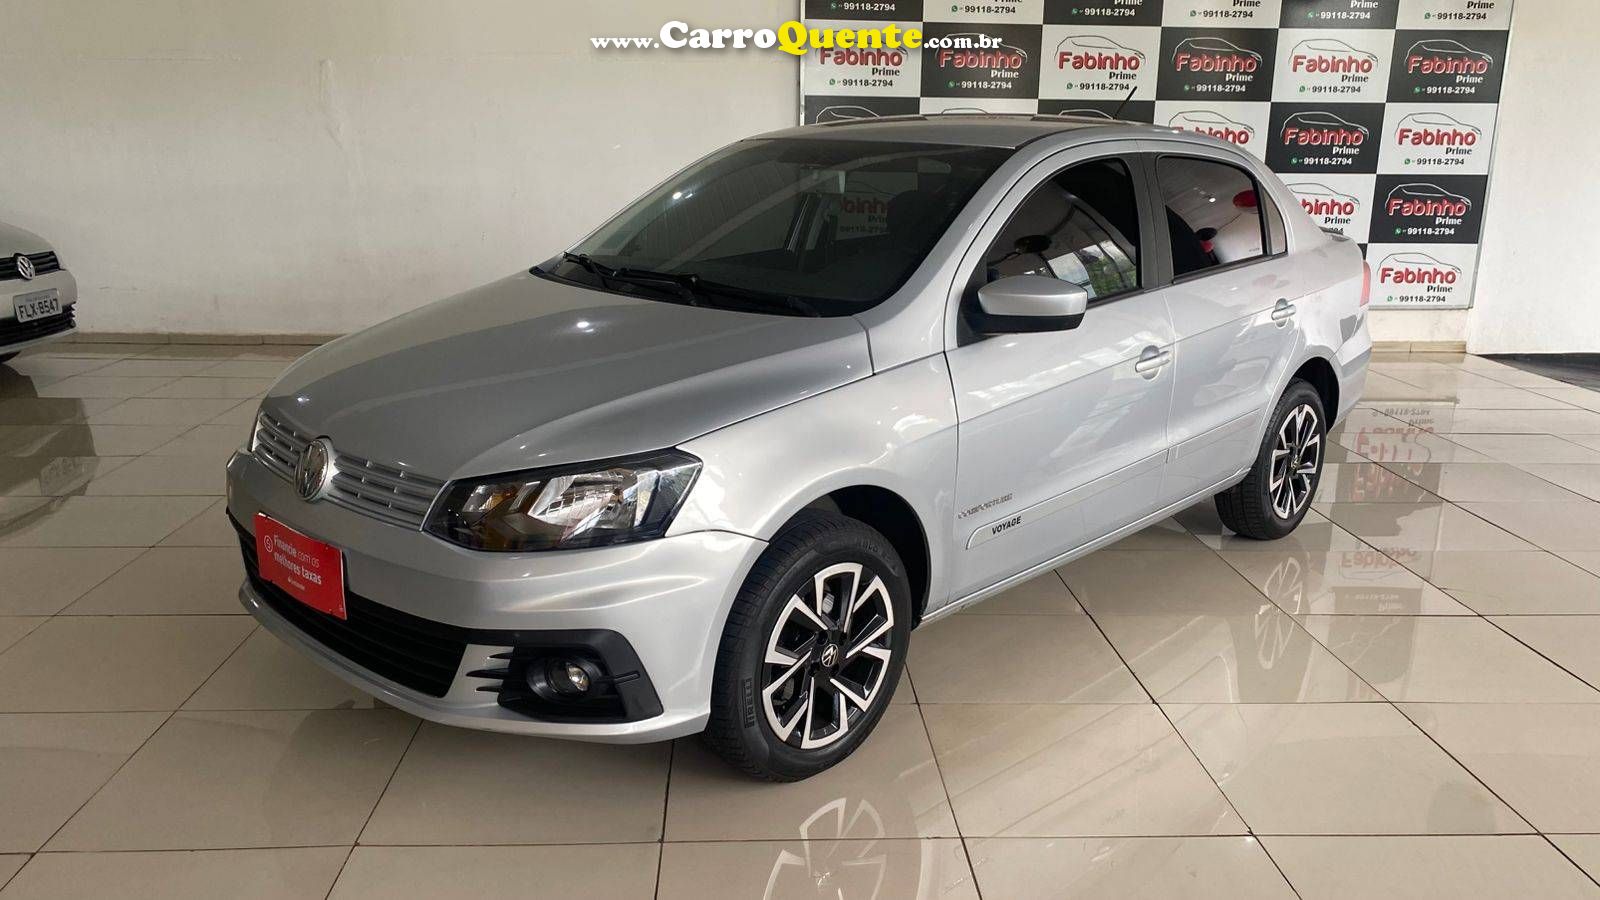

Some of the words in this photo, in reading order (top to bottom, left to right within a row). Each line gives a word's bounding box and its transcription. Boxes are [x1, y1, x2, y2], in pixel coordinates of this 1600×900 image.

[843, 2, 896, 11] 99118-2794
[1350, 0, 1379, 9] Prime
[1466, 1, 1495, 10] Prime
[964, 5, 1016, 14] 99118-2794
[1084, 7, 1136, 17] 99118-2794
[1202, 10, 1254, 18] 99118-2794
[1320, 11, 1371, 20] 99118-2794
[1437, 12, 1487, 20] 99118-2794
[819, 48, 903, 67] Fabinho
[939, 50, 1023, 69] Fabinho
[1058, 51, 1141, 71] Fabinho
[1175, 53, 1258, 73] Fabinho
[1292, 54, 1373, 74] Fabinho
[1407, 55, 1489, 75] Fabinho
[871, 67, 900, 77] Prime
[990, 69, 1019, 79] Prime
[1108, 71, 1137, 81] Prime
[1225, 73, 1254, 82] Prime
[1341, 74, 1369, 83] Prime
[1455, 75, 1484, 84] Prime
[842, 78, 893, 88] 99118-2794
[961, 81, 1012, 89] 99118-2794
[1079, 82, 1130, 91] 99118-2794
[1196, 84, 1246, 92] 99118-2794
[1312, 85, 1361, 93] 99118-2794
[1426, 86, 1476, 94] 99118-2794
[1284, 127, 1364, 146] Fabinho
[1398, 128, 1476, 146] Fabinho
[1332, 146, 1360, 155] Prime
[1445, 147, 1473, 155] Prime
[1303, 156, 1352, 165] 99118-2794
[1301, 198, 1355, 216] binho
[1387, 198, 1467, 216] Fabinho
[1324, 216, 1351, 225] Prime
[1435, 216, 1463, 225] Prime
[1380, 267, 1457, 285] Fabinho
[1427, 285, 1453, 293] Prime
[1399, 295, 1446, 303] 99118-2794
[991, 515, 1022, 535] VOYAGE
[273, 534, 297, 557] Financie
[297, 551, 311, 563] com
[274, 552, 301, 576] melhores
[301, 566, 322, 585] taxas
